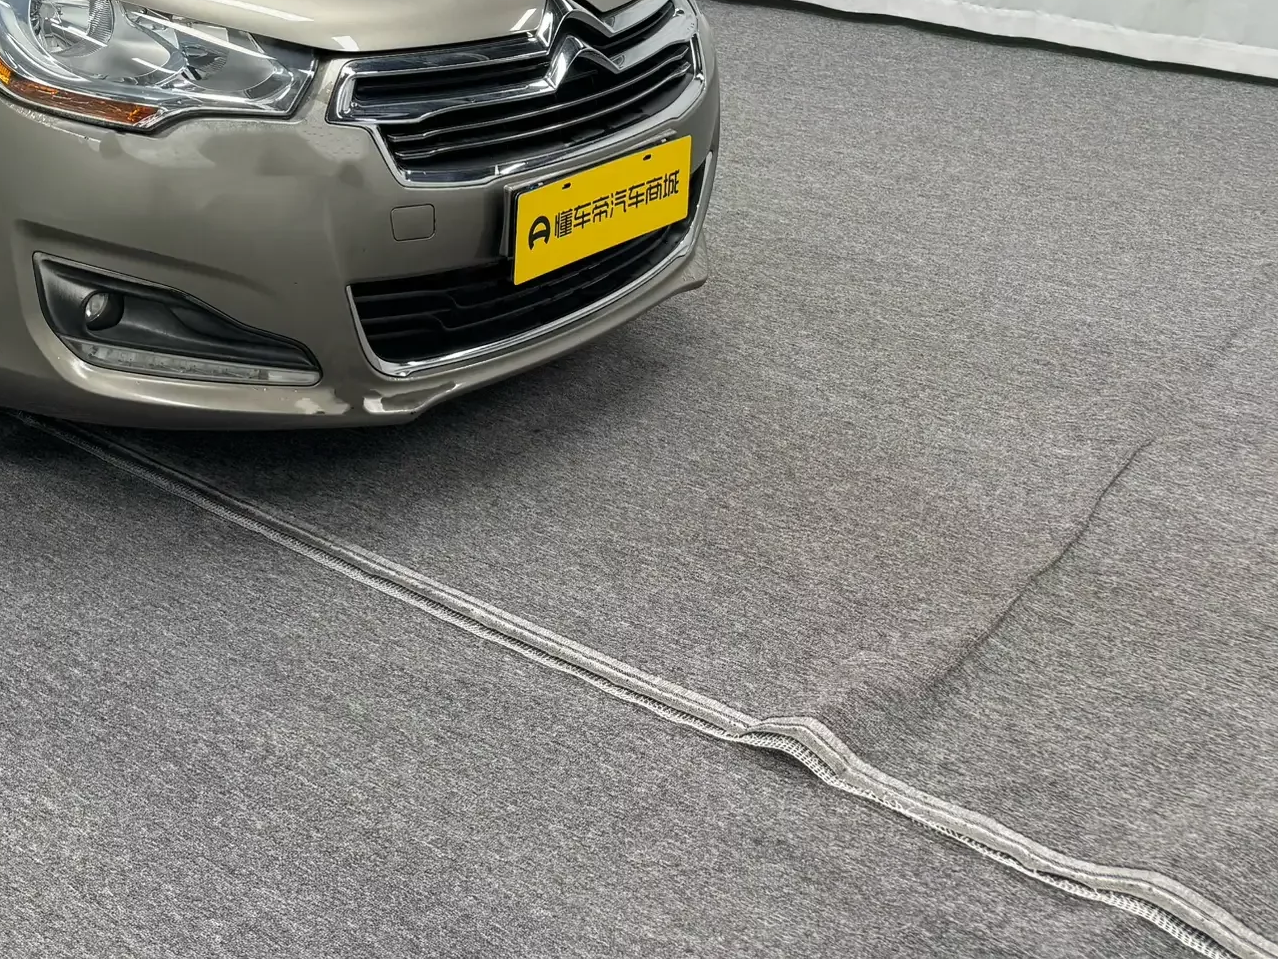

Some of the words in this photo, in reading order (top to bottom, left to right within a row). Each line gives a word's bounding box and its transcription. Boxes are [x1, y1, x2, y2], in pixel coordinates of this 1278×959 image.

[554, 169, 680, 239] 懂车帝汽车商城
